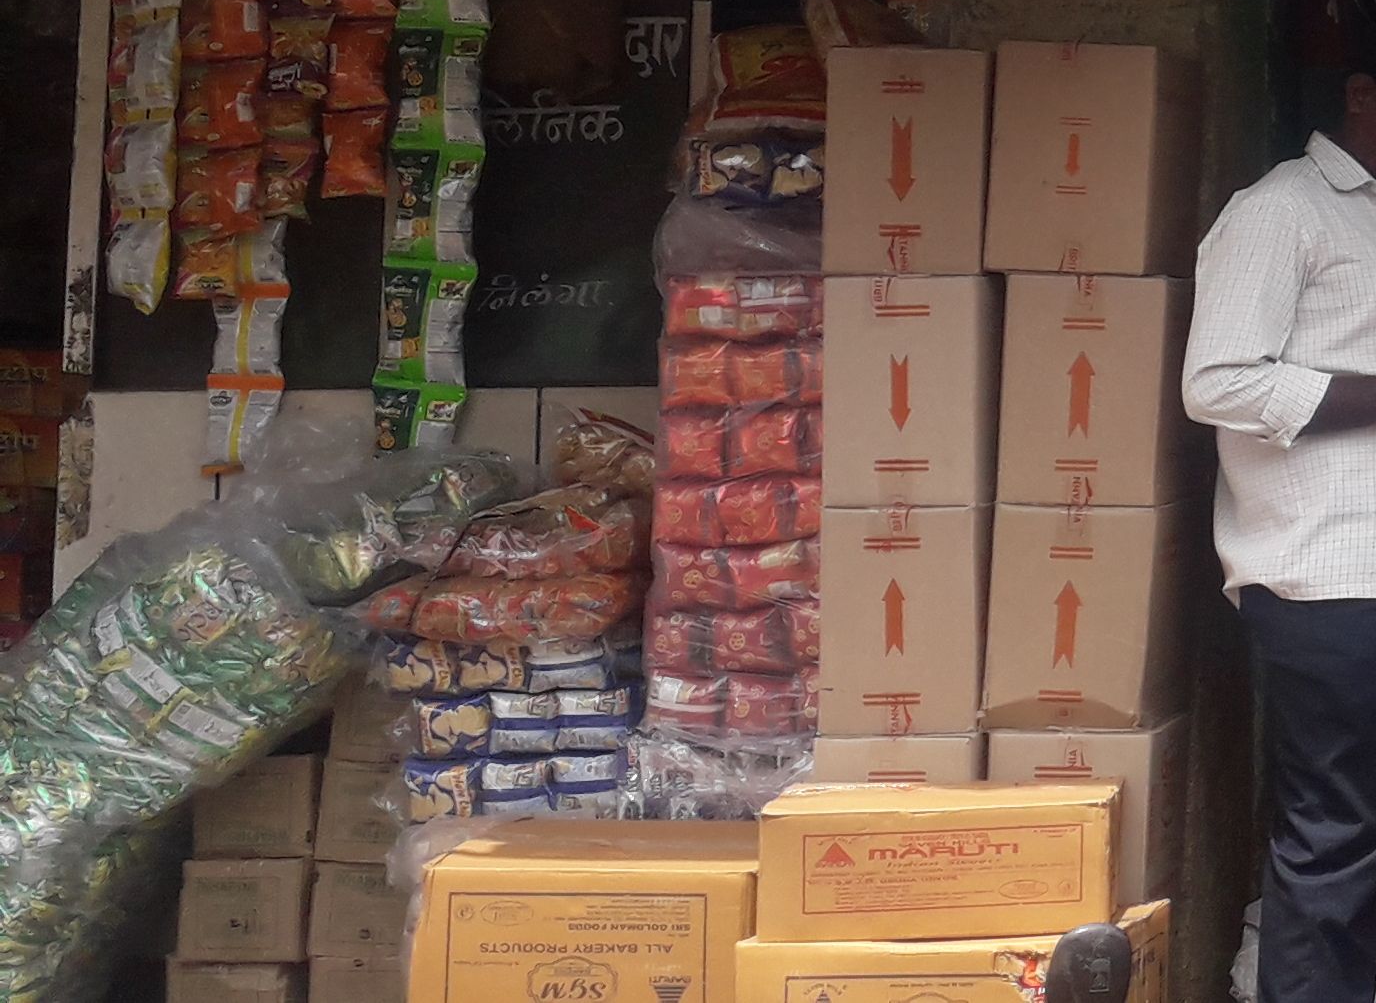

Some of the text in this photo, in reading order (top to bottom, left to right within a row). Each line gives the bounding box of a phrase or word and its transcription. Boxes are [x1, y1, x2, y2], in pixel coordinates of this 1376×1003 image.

[868, 843, 1019, 861] MARUTI
[479, 942, 674, 954] ALL BAKERY PRODUCTS
[540, 977, 607, 1001] SGM
